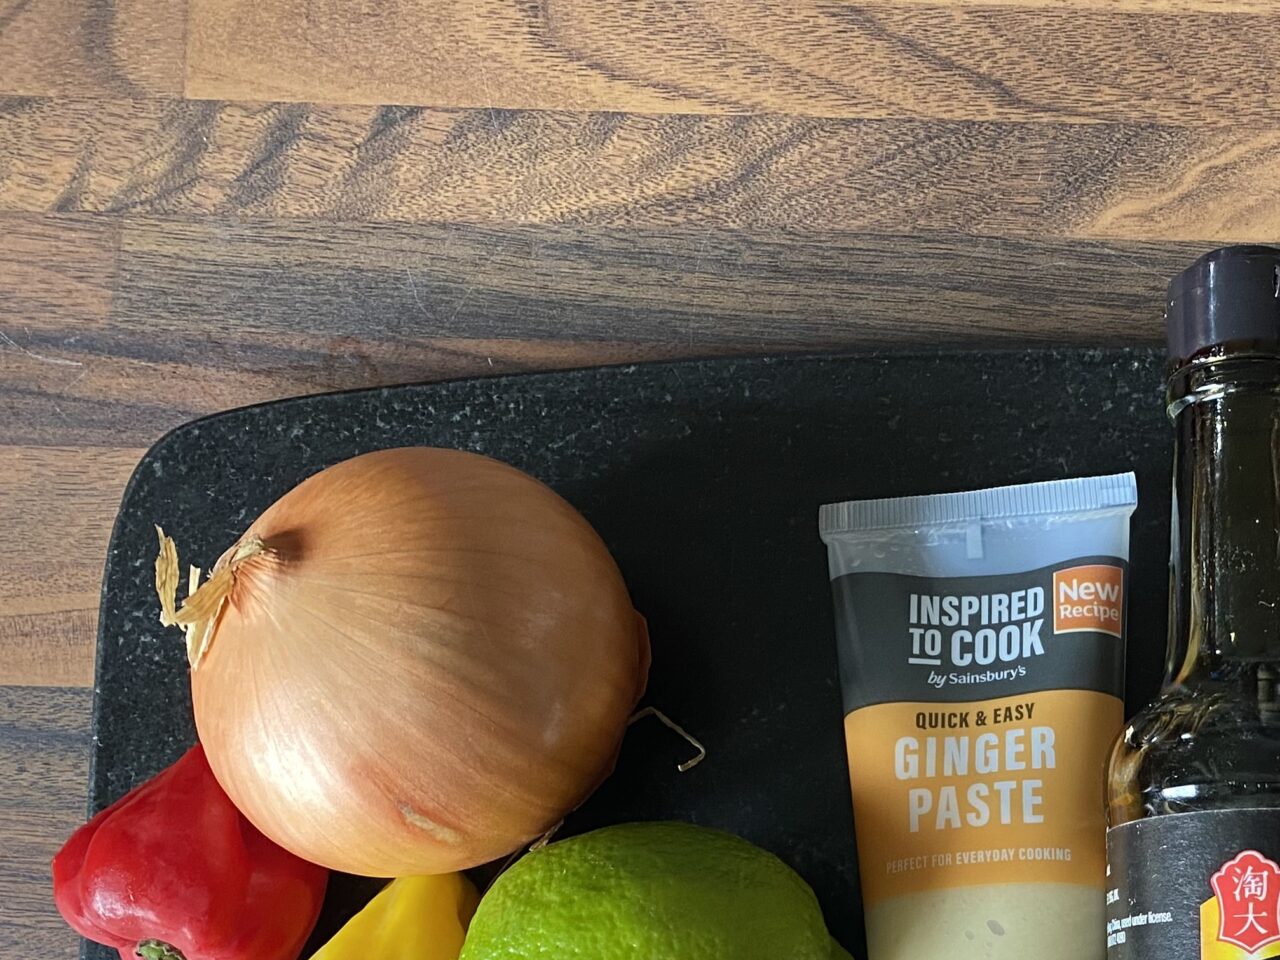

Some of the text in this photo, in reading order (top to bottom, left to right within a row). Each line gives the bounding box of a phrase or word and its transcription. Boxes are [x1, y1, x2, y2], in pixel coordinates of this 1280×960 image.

[1059, 578, 1119, 602] New
[909, 586, 1044, 625] INSPIRED
[1059, 603, 1119, 622] Recipe
[909, 621, 1044, 667] TO COOK
[927, 665, 1026, 688] by Sainsbury's
[916, 702, 1035, 730] QUICK & EASY
[894, 726, 1056, 780] GINGER
[909, 779, 1044, 833] PASTE
[886, 847, 1072, 874] PERFECT FOR EVERYDAY COOKING
